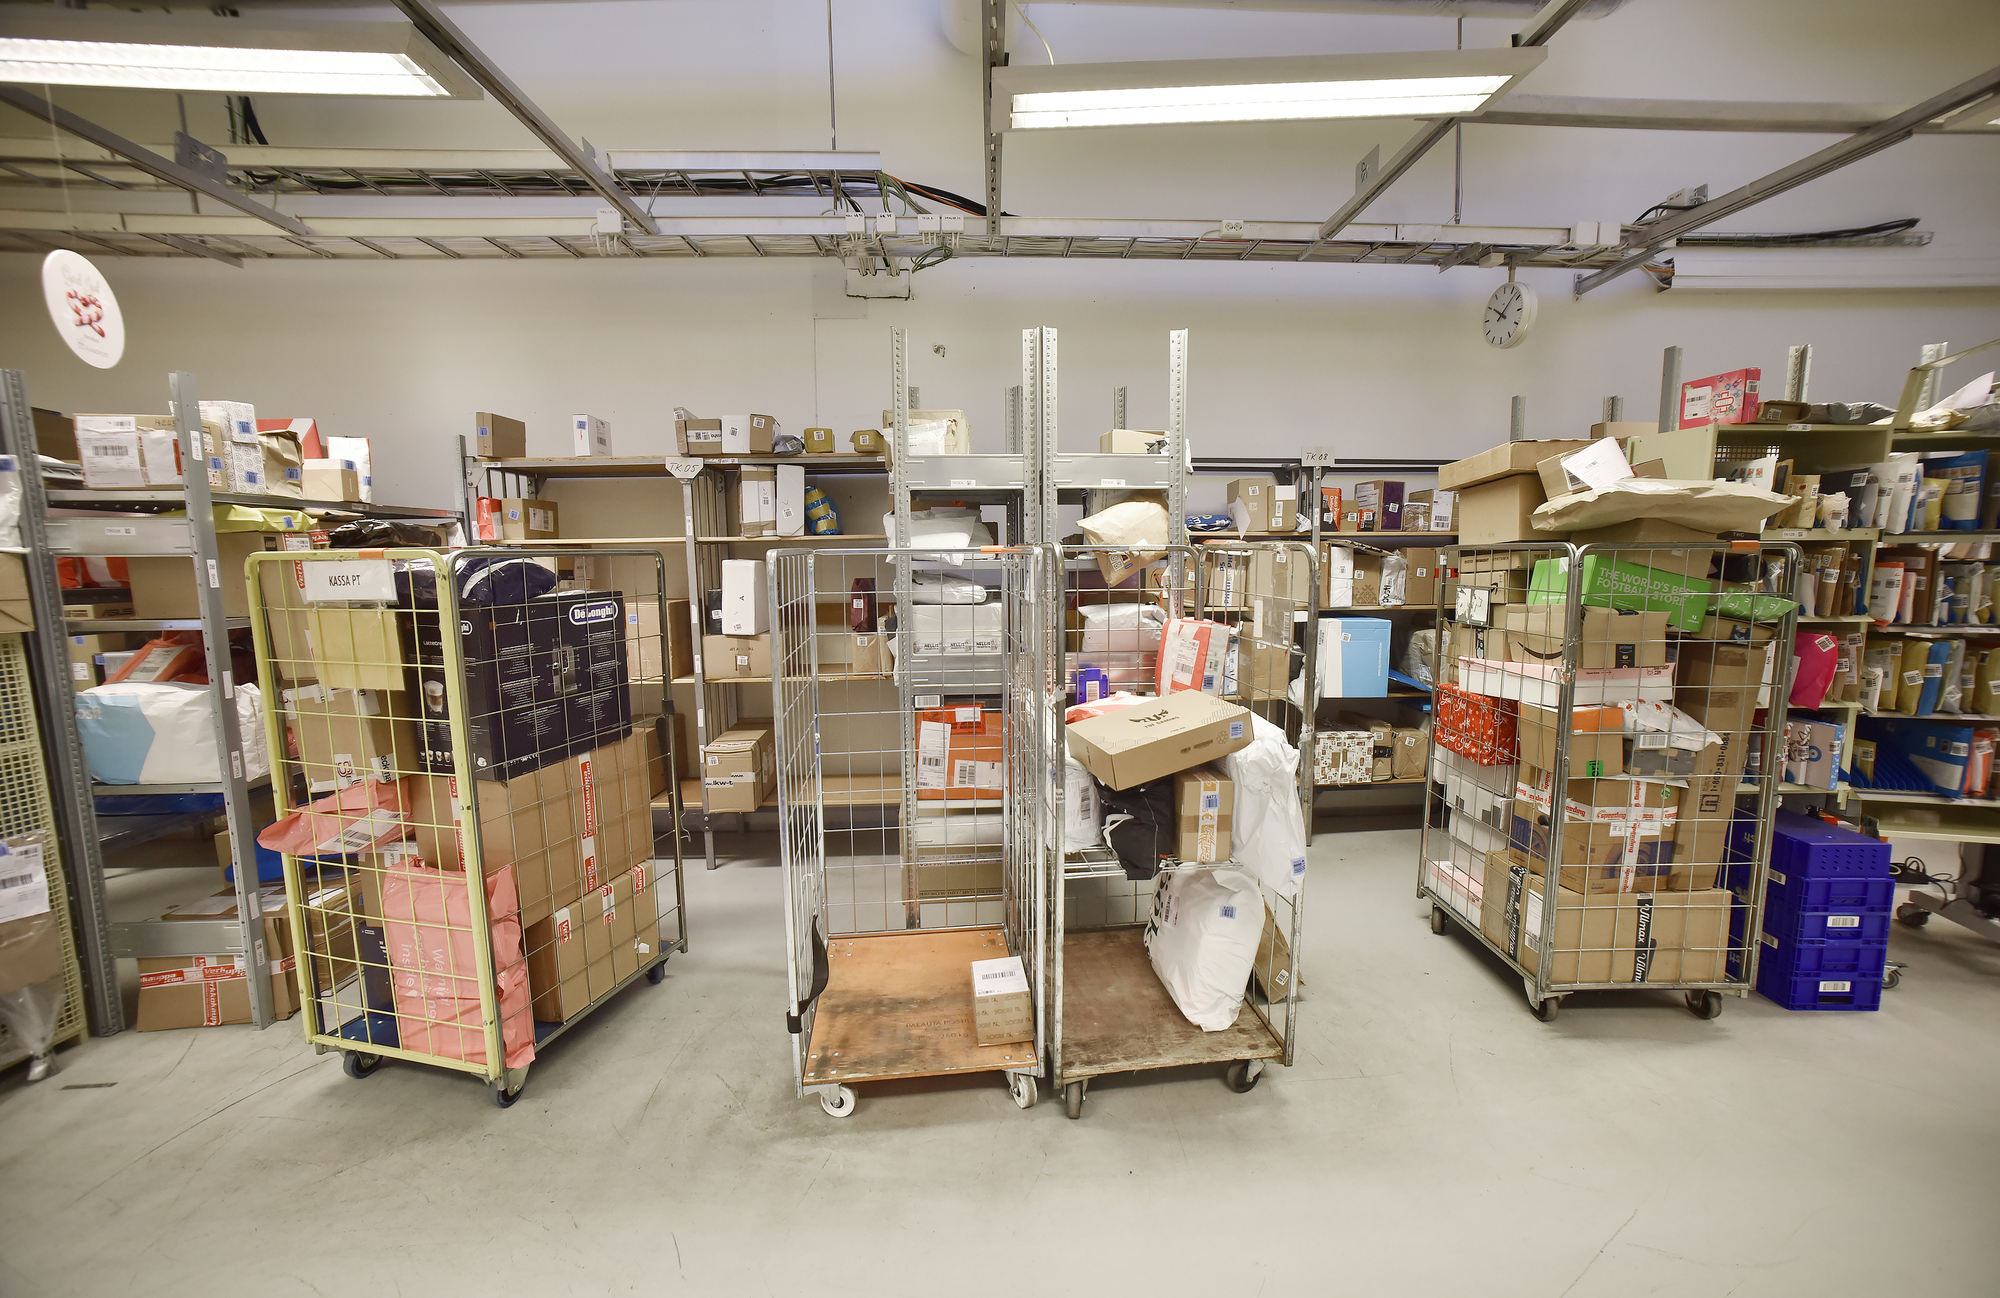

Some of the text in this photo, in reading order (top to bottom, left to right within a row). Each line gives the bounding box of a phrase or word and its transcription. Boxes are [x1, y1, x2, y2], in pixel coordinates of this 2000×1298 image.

[1318, 452, 1329, 461] 08
[669, 462, 700, 473] TK 05
[329, 574, 361, 587] KASSA PT
[1600, 567, 1619, 580] THE
[1621, 572, 1670, 593] WORLD'S
